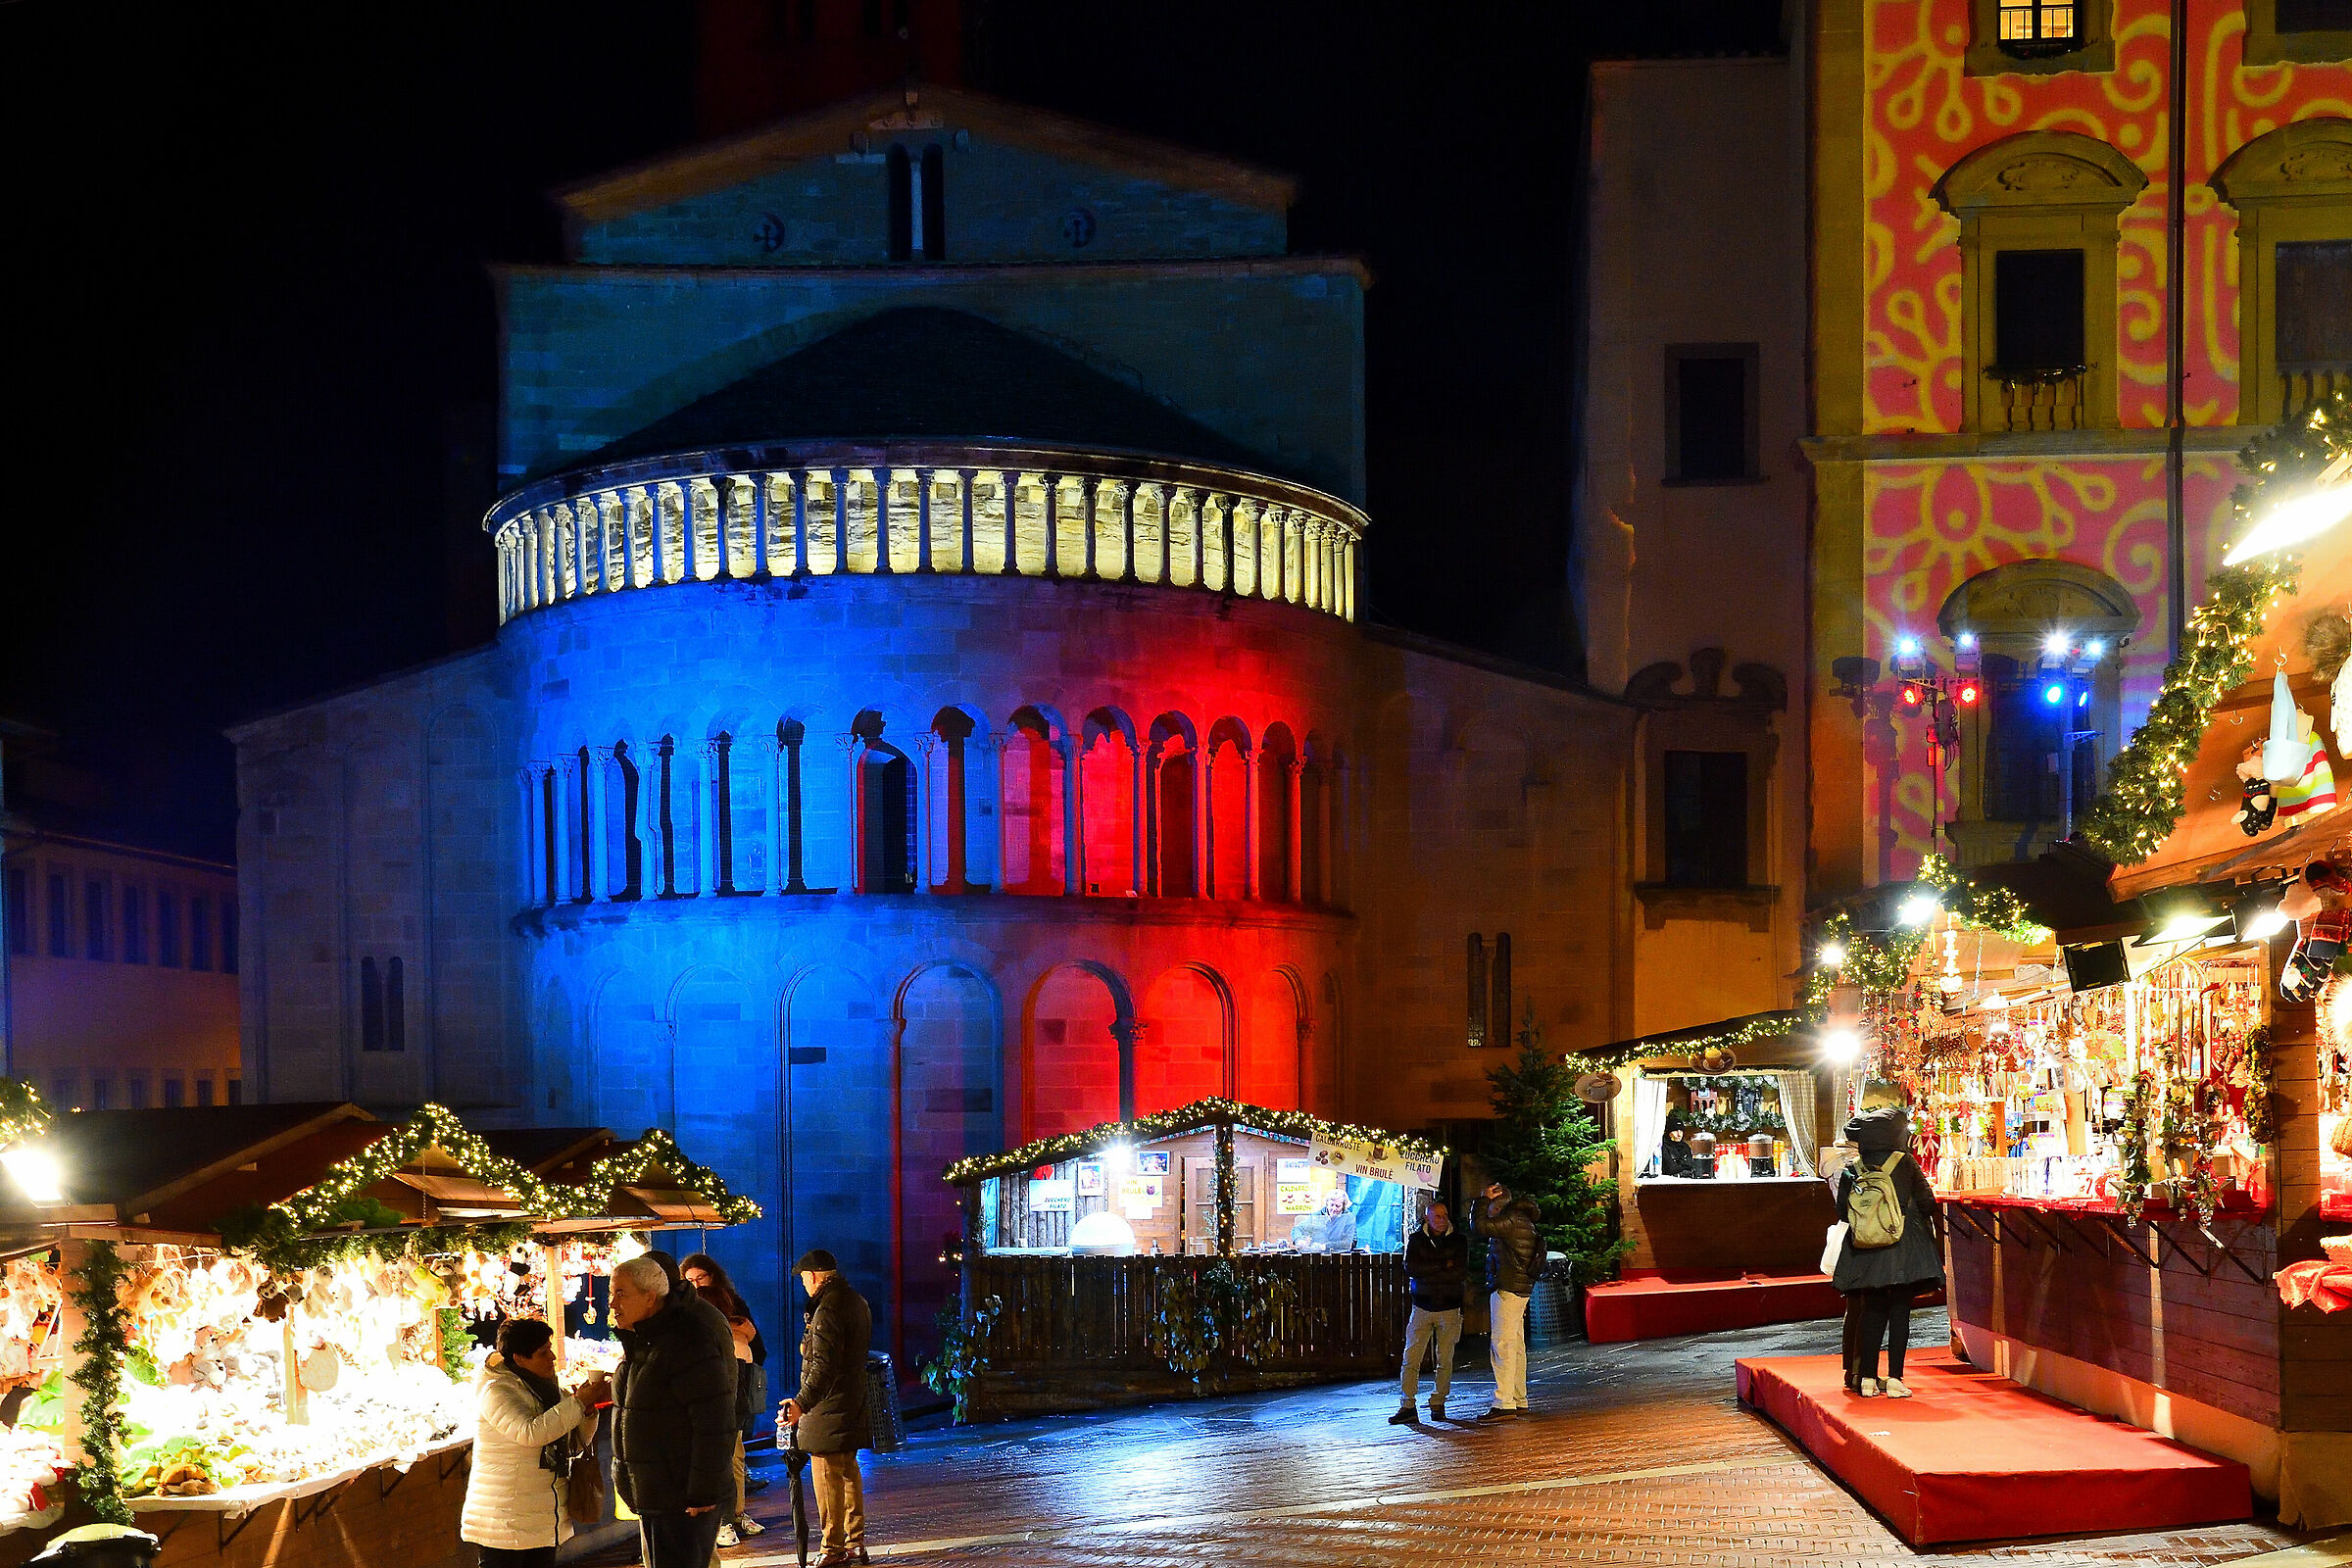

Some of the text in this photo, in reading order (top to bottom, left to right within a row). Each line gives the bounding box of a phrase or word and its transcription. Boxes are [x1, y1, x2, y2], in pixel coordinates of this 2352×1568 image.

[1399, 1150, 1441, 1165] ZUCCHERO
[1355, 1163, 1394, 1180] VIN BRULÈ
[1404, 1161, 1432, 1174] FILATO
